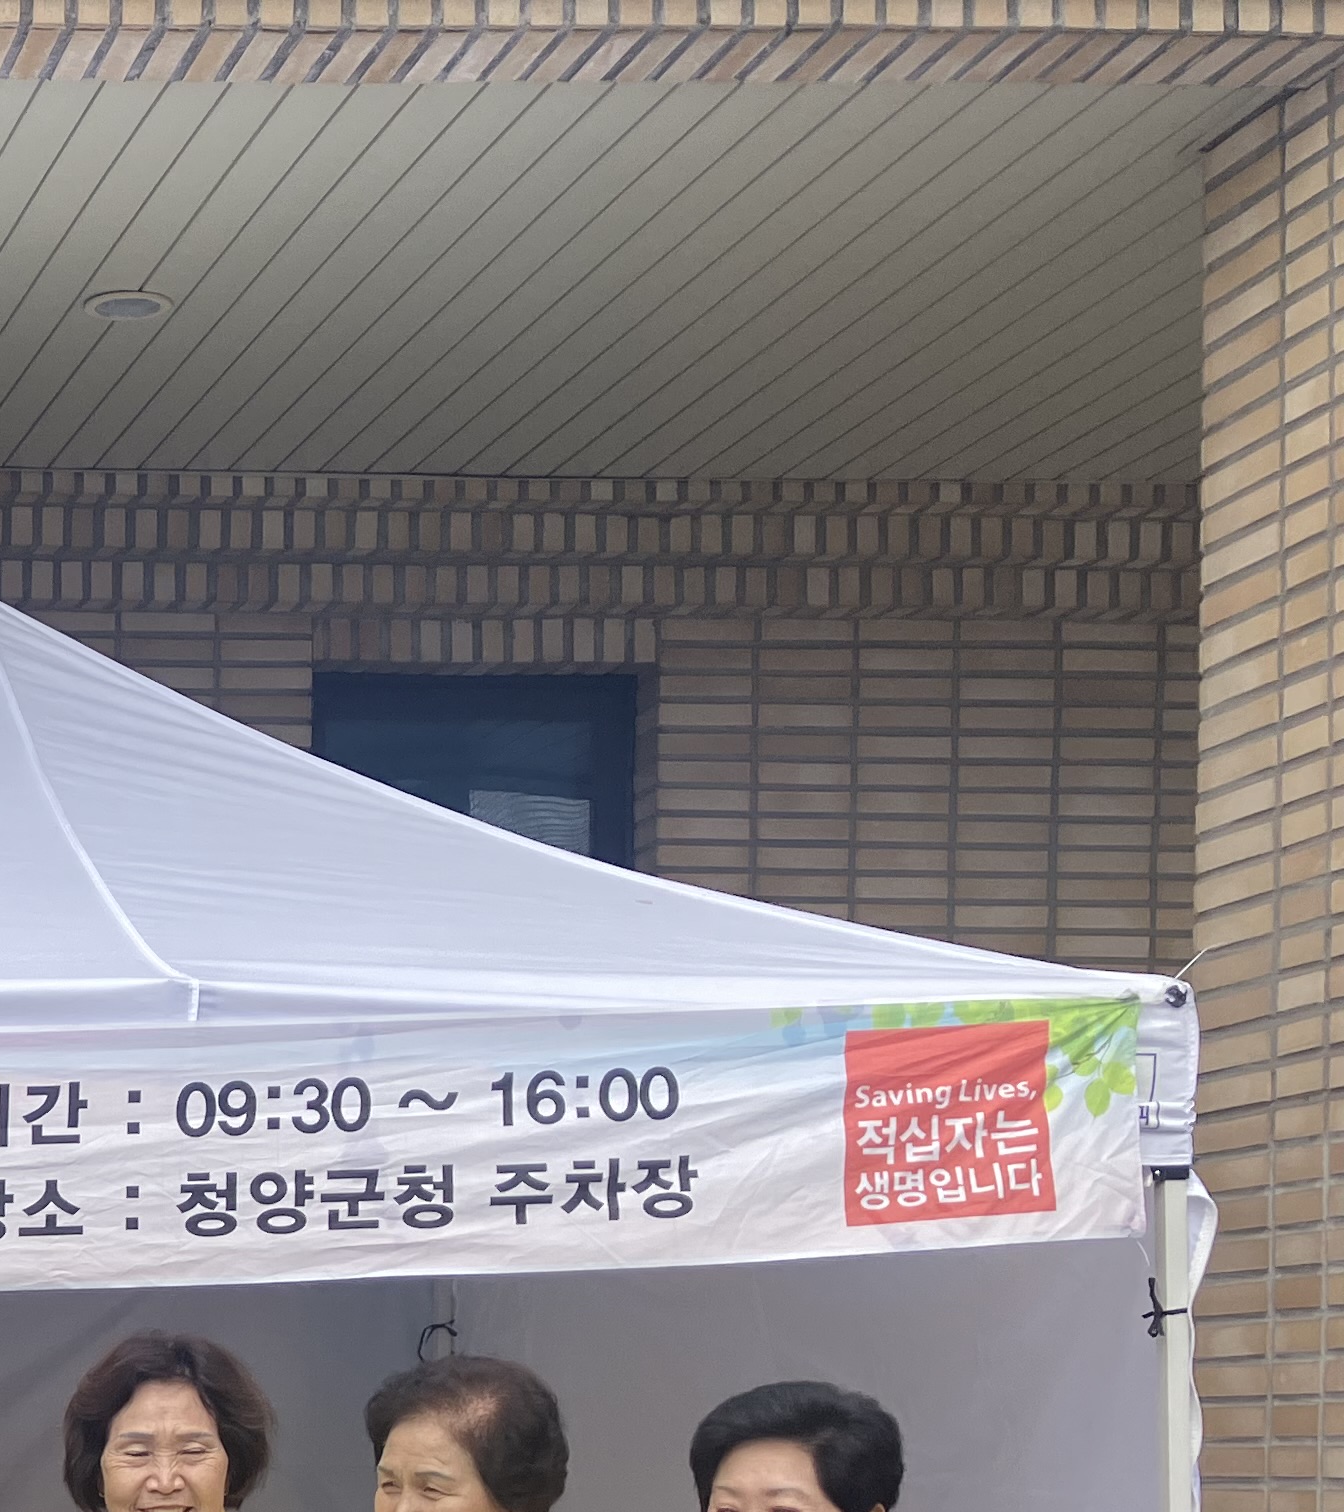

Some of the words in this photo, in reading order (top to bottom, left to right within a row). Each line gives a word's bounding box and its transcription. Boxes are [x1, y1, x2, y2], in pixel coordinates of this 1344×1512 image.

[176, 1077, 371, 1138] 09:30
[491, 1067, 679, 1127] 16:00
[855, 1082, 952, 1109] Saving
[959, 1078, 1037, 1103] Lives,
[856, 1110, 1039, 1165] 적십자는
[176, 1164, 454, 1237] 청양군청
[489, 1155, 698, 1225] 주차장
[855, 1159, 1042, 1210] 생명입니다
